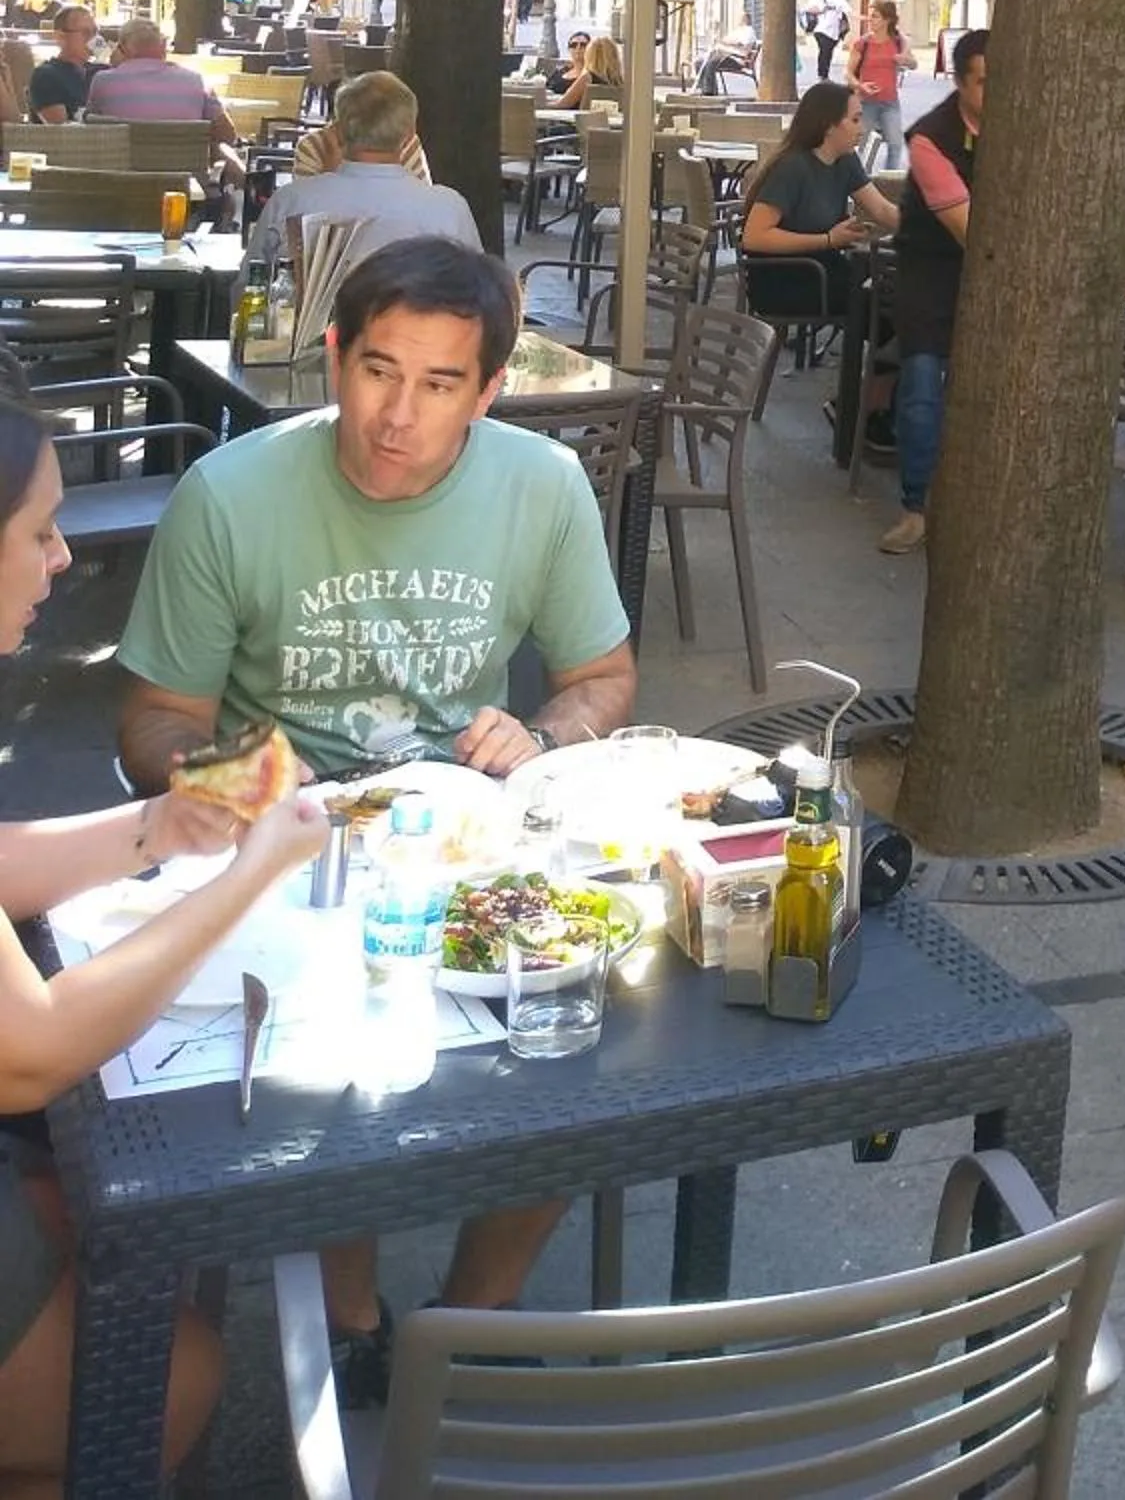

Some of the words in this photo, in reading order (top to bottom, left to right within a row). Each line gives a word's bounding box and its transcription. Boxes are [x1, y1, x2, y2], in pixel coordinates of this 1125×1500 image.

[297, 568, 494, 617] MICHAEL'S
[346, 618, 444, 645] HOME
[278, 636, 497, 696] BREWERY
